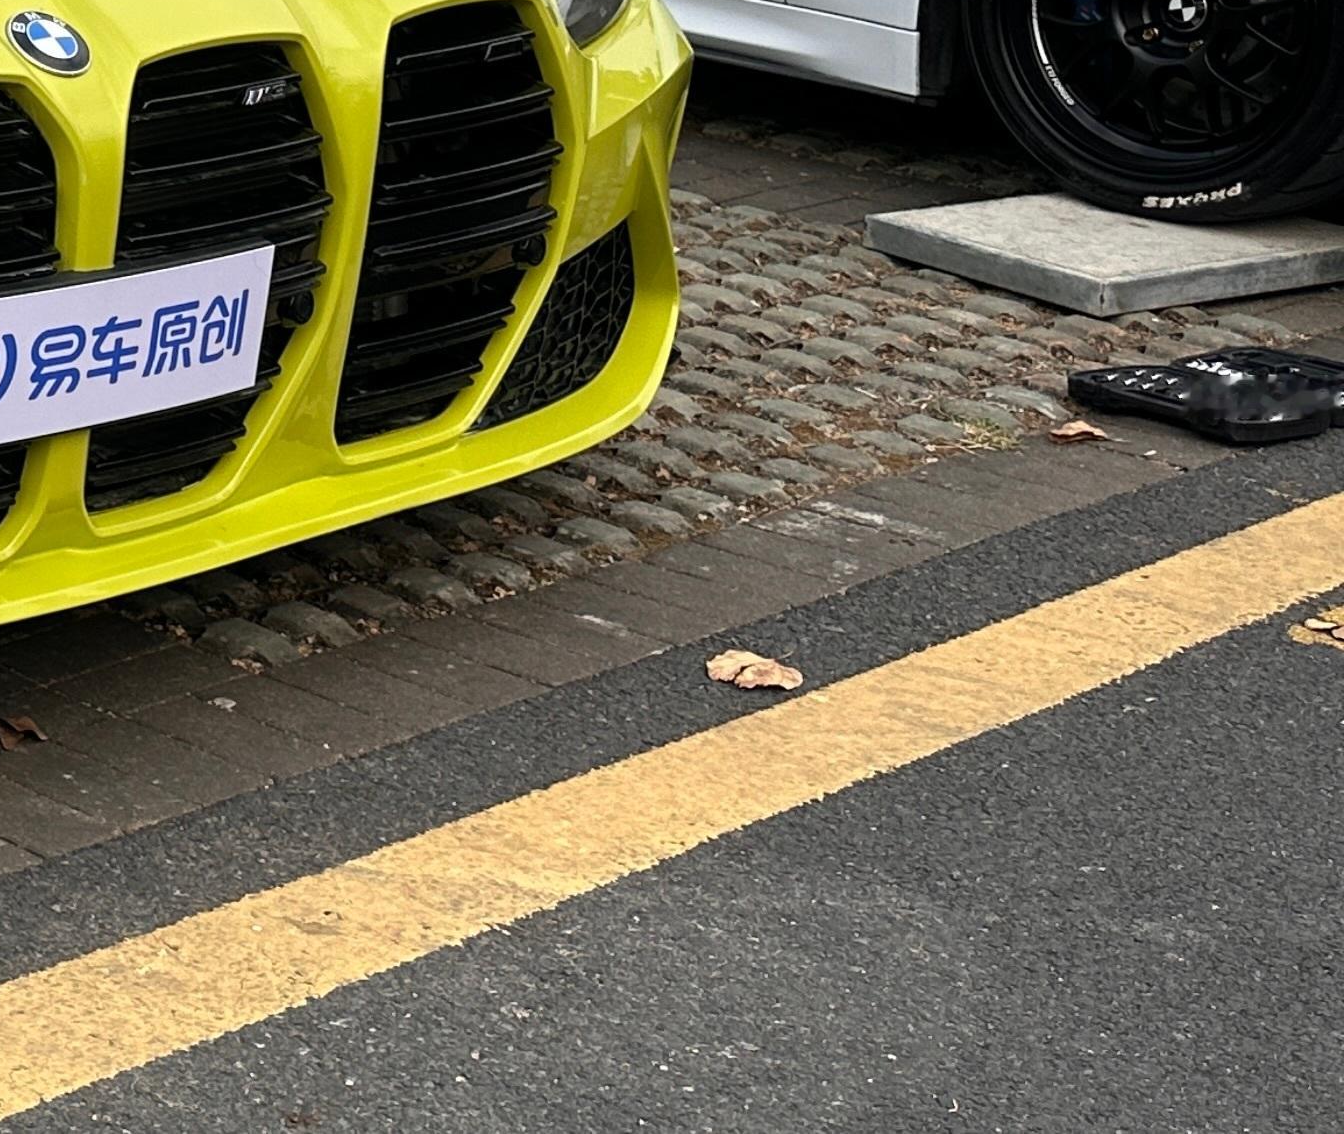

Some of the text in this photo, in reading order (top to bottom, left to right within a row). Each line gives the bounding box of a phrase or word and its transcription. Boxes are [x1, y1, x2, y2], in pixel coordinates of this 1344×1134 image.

[12, 11, 67, 34] BMW
[28, 289, 249, 400] 易车原创
